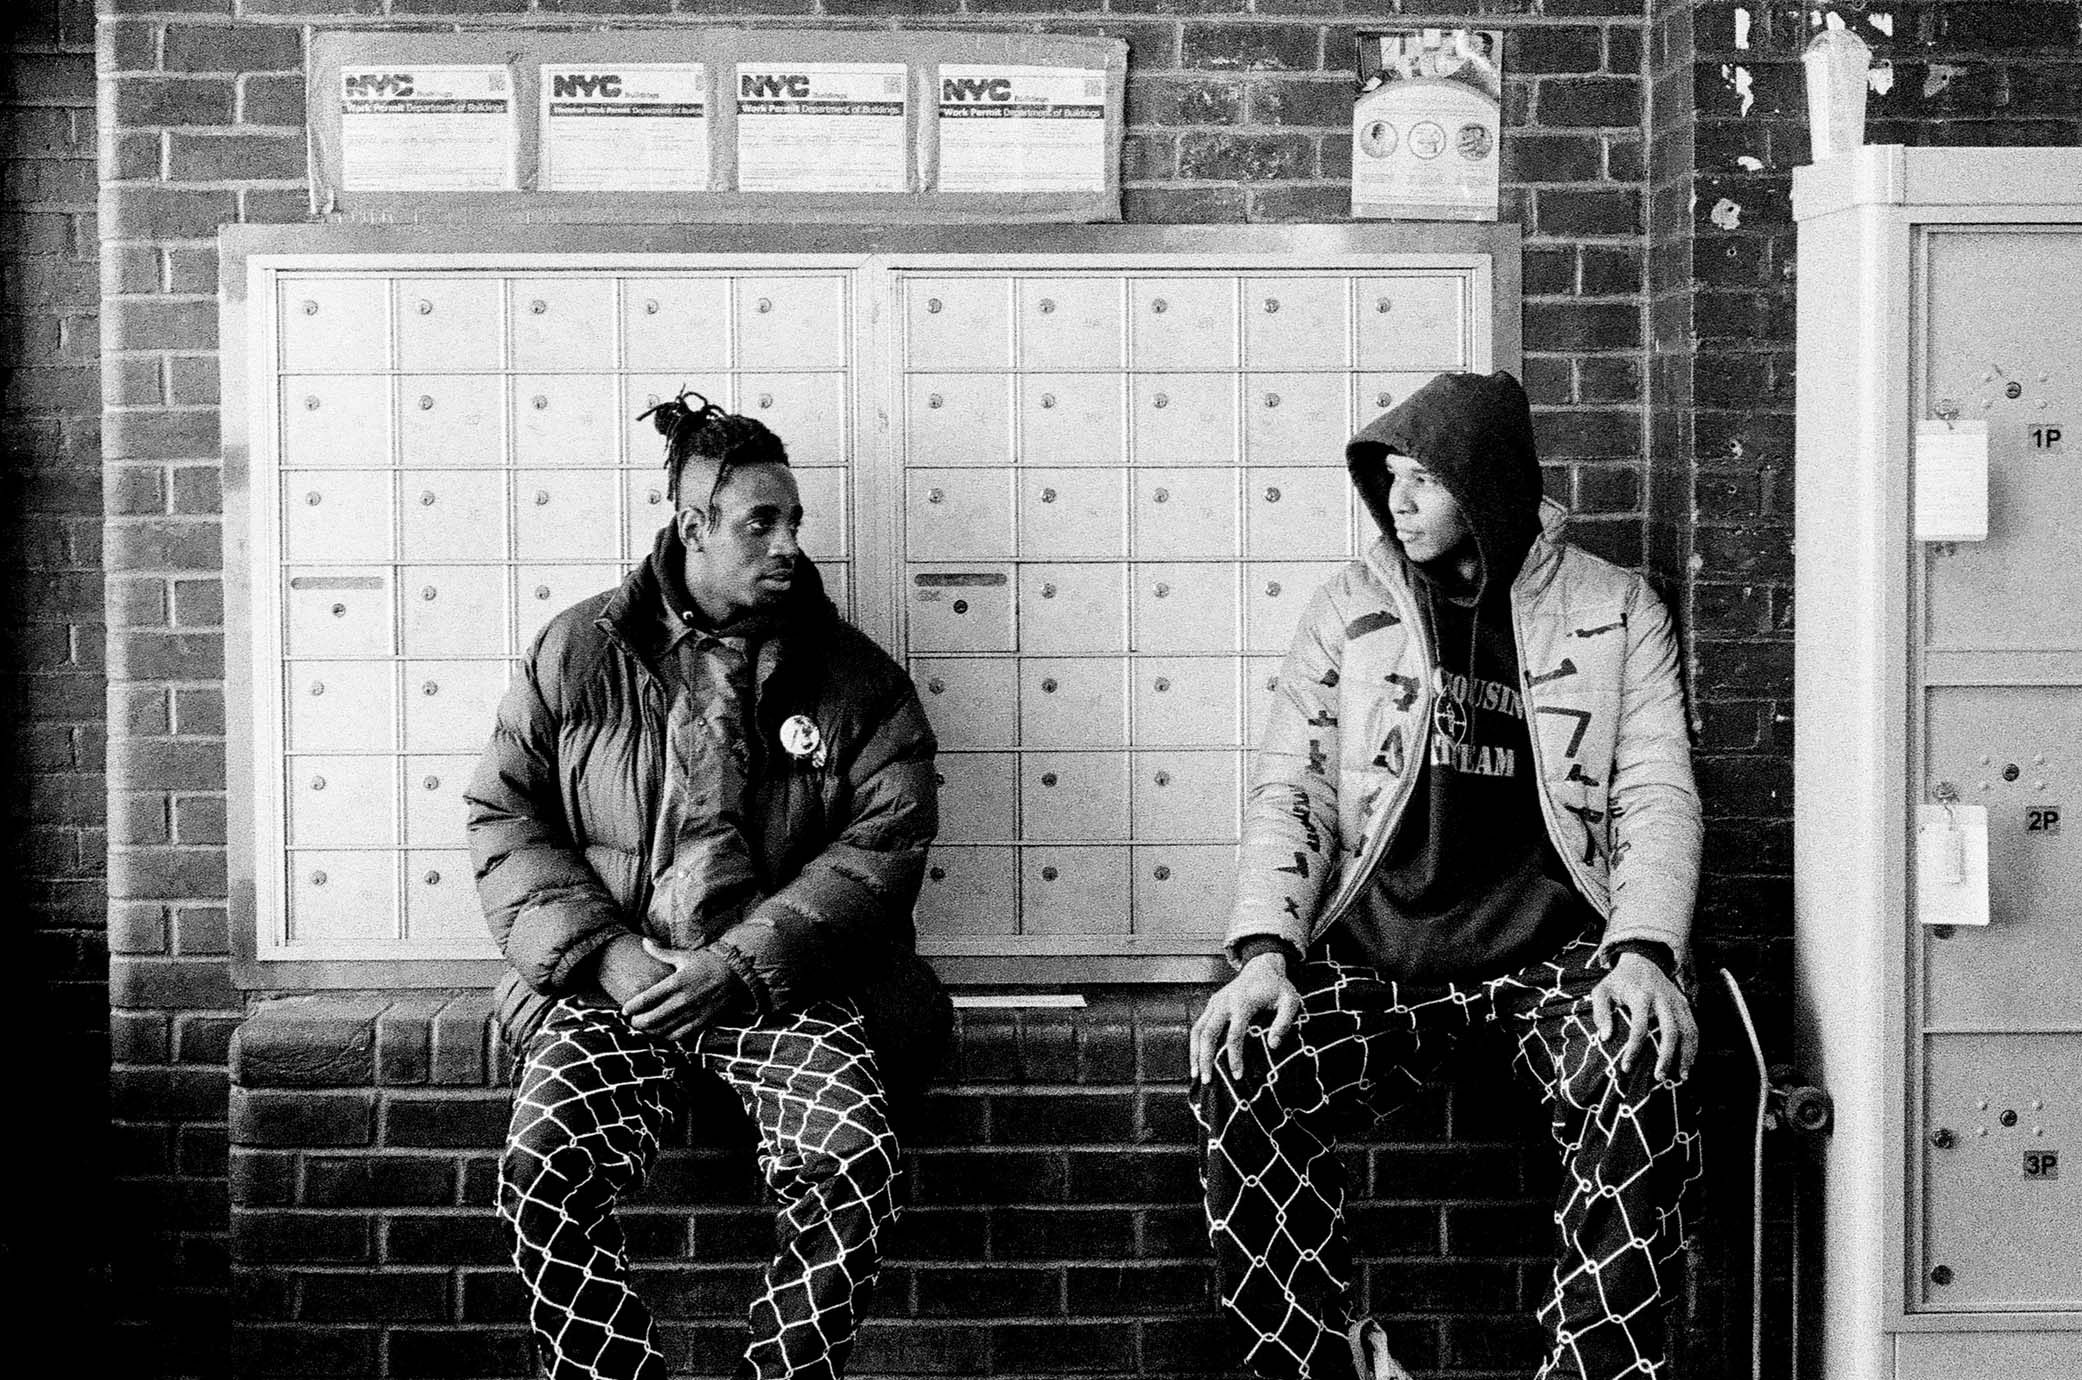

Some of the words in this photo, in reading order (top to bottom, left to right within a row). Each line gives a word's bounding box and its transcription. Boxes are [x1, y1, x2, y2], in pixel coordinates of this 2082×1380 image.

[345, 74, 414, 97] NYC
[553, 74, 622, 98] NYC
[741, 74, 810, 98] NYC
[943, 78, 1012, 102] NYC
[347, 104, 371, 113] Work
[374, 104, 405, 113] Permit
[406, 104, 456, 114] Department
[457, 104, 466, 113] of
[467, 104, 505, 114] Buildings
[742, 104, 766, 113] Work
[768, 104, 800, 113] Permit
[801, 104, 850, 114] Department
[851, 104, 861, 113] of
[862, 105, 900, 115] Buildings
[943, 109, 968, 117] Work
[970, 109, 1003, 117] Permit
[1003, 109, 1051, 118] Department
[1052, 109, 1063, 118] of
[1063, 109, 1101, 119] Buildings
[2032, 429, 2061, 448] 1P
[2029, 811, 2059, 831] 2P
[2027, 1155, 2057, 1176] 3P
